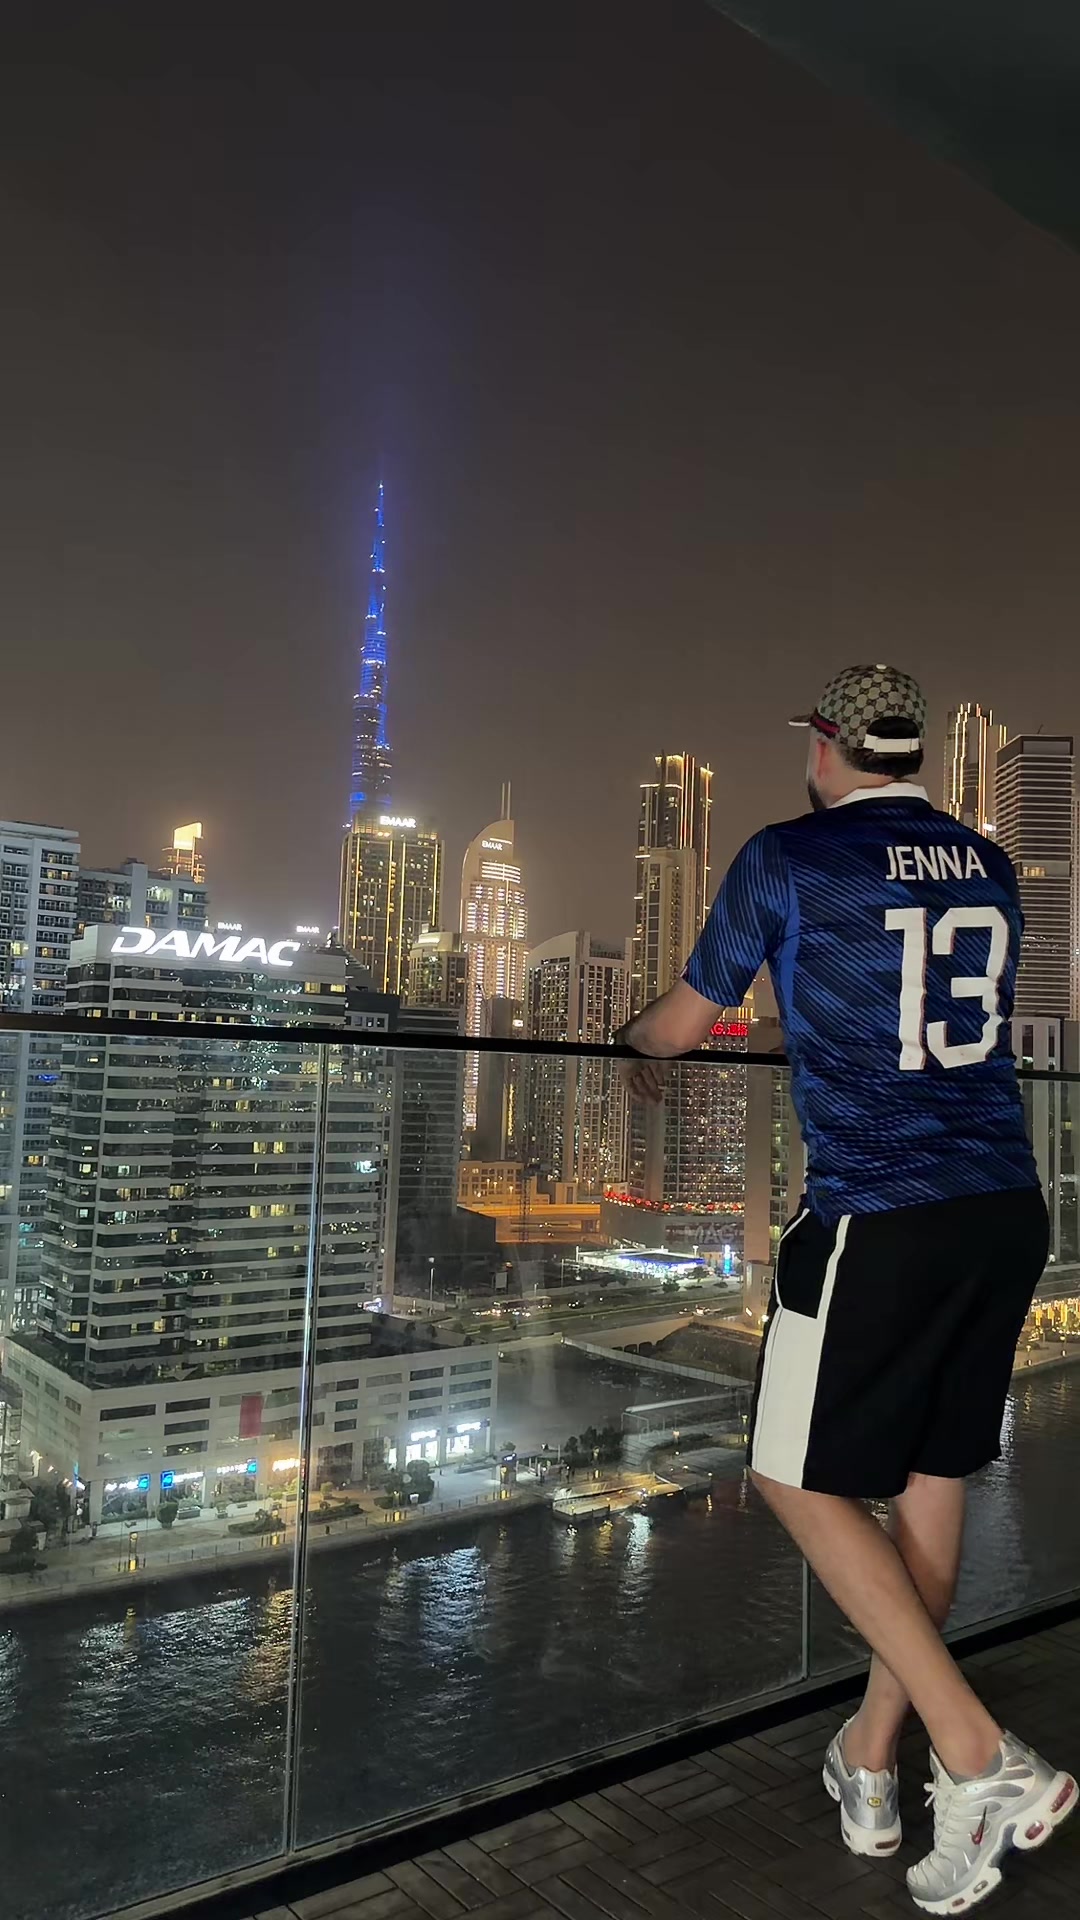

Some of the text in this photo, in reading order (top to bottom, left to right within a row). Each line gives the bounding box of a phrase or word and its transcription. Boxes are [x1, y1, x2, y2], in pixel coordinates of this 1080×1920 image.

[379, 815, 416, 828] EMAAR
[481, 840, 503, 851] EMAAR
[885, 845, 988, 881] JENNA
[217, 921, 242, 931] EMAAR
[296, 925, 320, 933] EMAAR
[111, 926, 300, 967] DAMAC
[884, 905, 1005, 1071] 13
